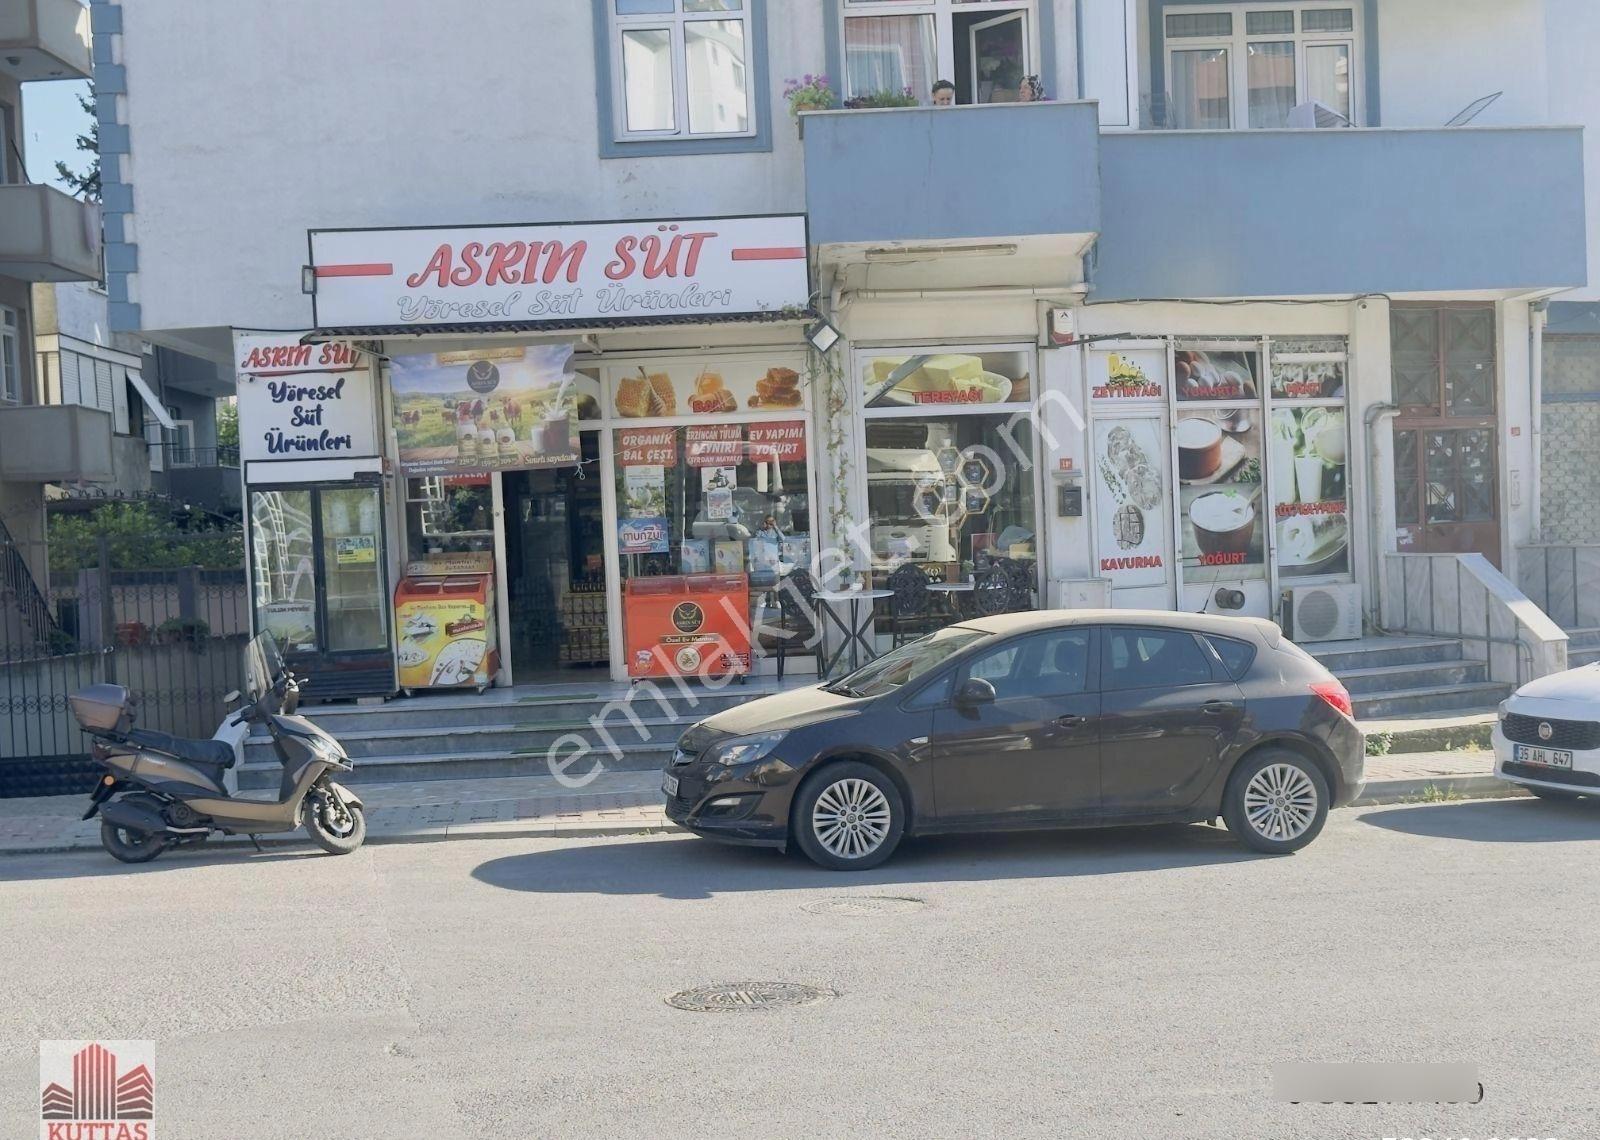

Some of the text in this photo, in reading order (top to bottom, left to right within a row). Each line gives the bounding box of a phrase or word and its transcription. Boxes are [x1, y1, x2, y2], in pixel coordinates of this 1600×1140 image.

[406, 224, 718, 288] ASRIN SÜT
[397, 282, 732, 322] Yöresel Süt Ürünleri
[241, 345, 312, 369] ASRIN
[267, 378, 346, 404] Yöresel
[911, 386, 984, 404] TEREYAĞI
[290, 403, 324, 427] Süt
[264, 426, 352, 454] Ürünleri
[622, 432, 673, 446] ORGANİK
[749, 427, 804, 441] EV YAPIMI
[623, 448, 674, 463] BAL ÇEŞT.
[1100, 555, 1164, 571] KAVURMA
[1198, 550, 1248, 566] YOĞURT
[1519, 747, 1570, 766] 35 AHL 647
